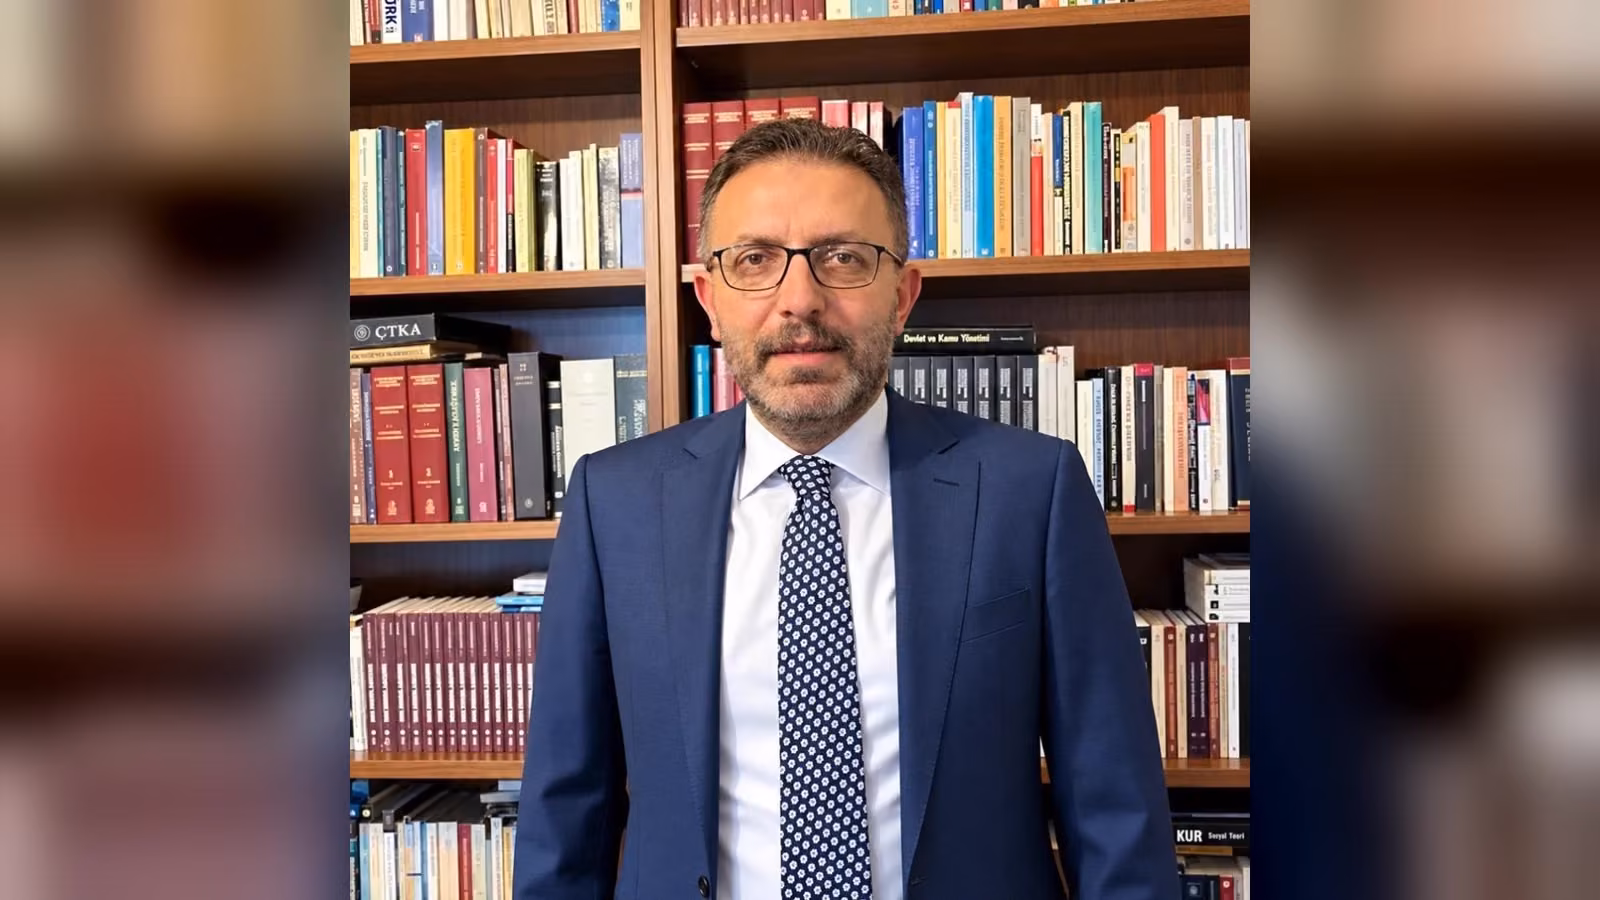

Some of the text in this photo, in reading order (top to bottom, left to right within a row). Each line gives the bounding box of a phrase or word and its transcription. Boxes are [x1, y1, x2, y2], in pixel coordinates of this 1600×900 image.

[375, 322, 421, 340] ÇTKA
[903, 333, 926, 343] Devlet
[928, 335, 936, 343] ve
[938, 333, 959, 343] Kamu
[960, 332, 990, 343] Yönetimi
[1176, 829, 1203, 843] KUR
[1229, 832, 1245, 840] Teori
